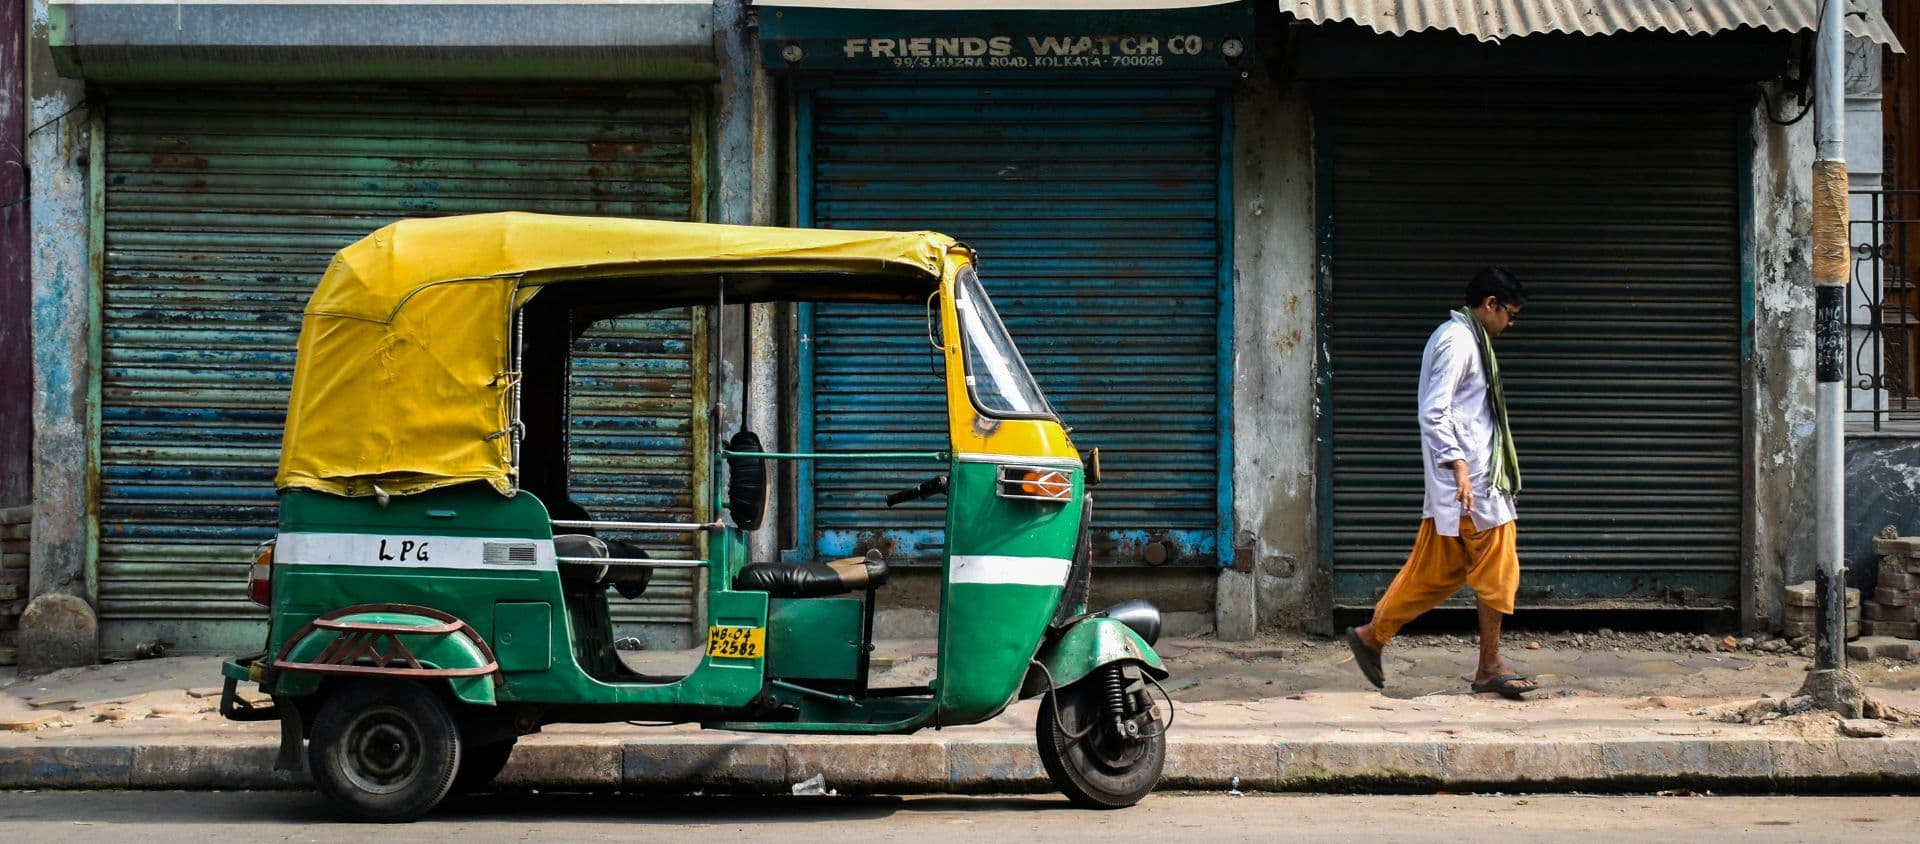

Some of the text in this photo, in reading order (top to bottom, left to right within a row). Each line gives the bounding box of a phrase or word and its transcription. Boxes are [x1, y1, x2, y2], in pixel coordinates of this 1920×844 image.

[843, 34, 1203, 58] FRIENDS WATCH CO
[1111, 55, 1164, 67] 700026
[378, 538, 430, 562] LPG
